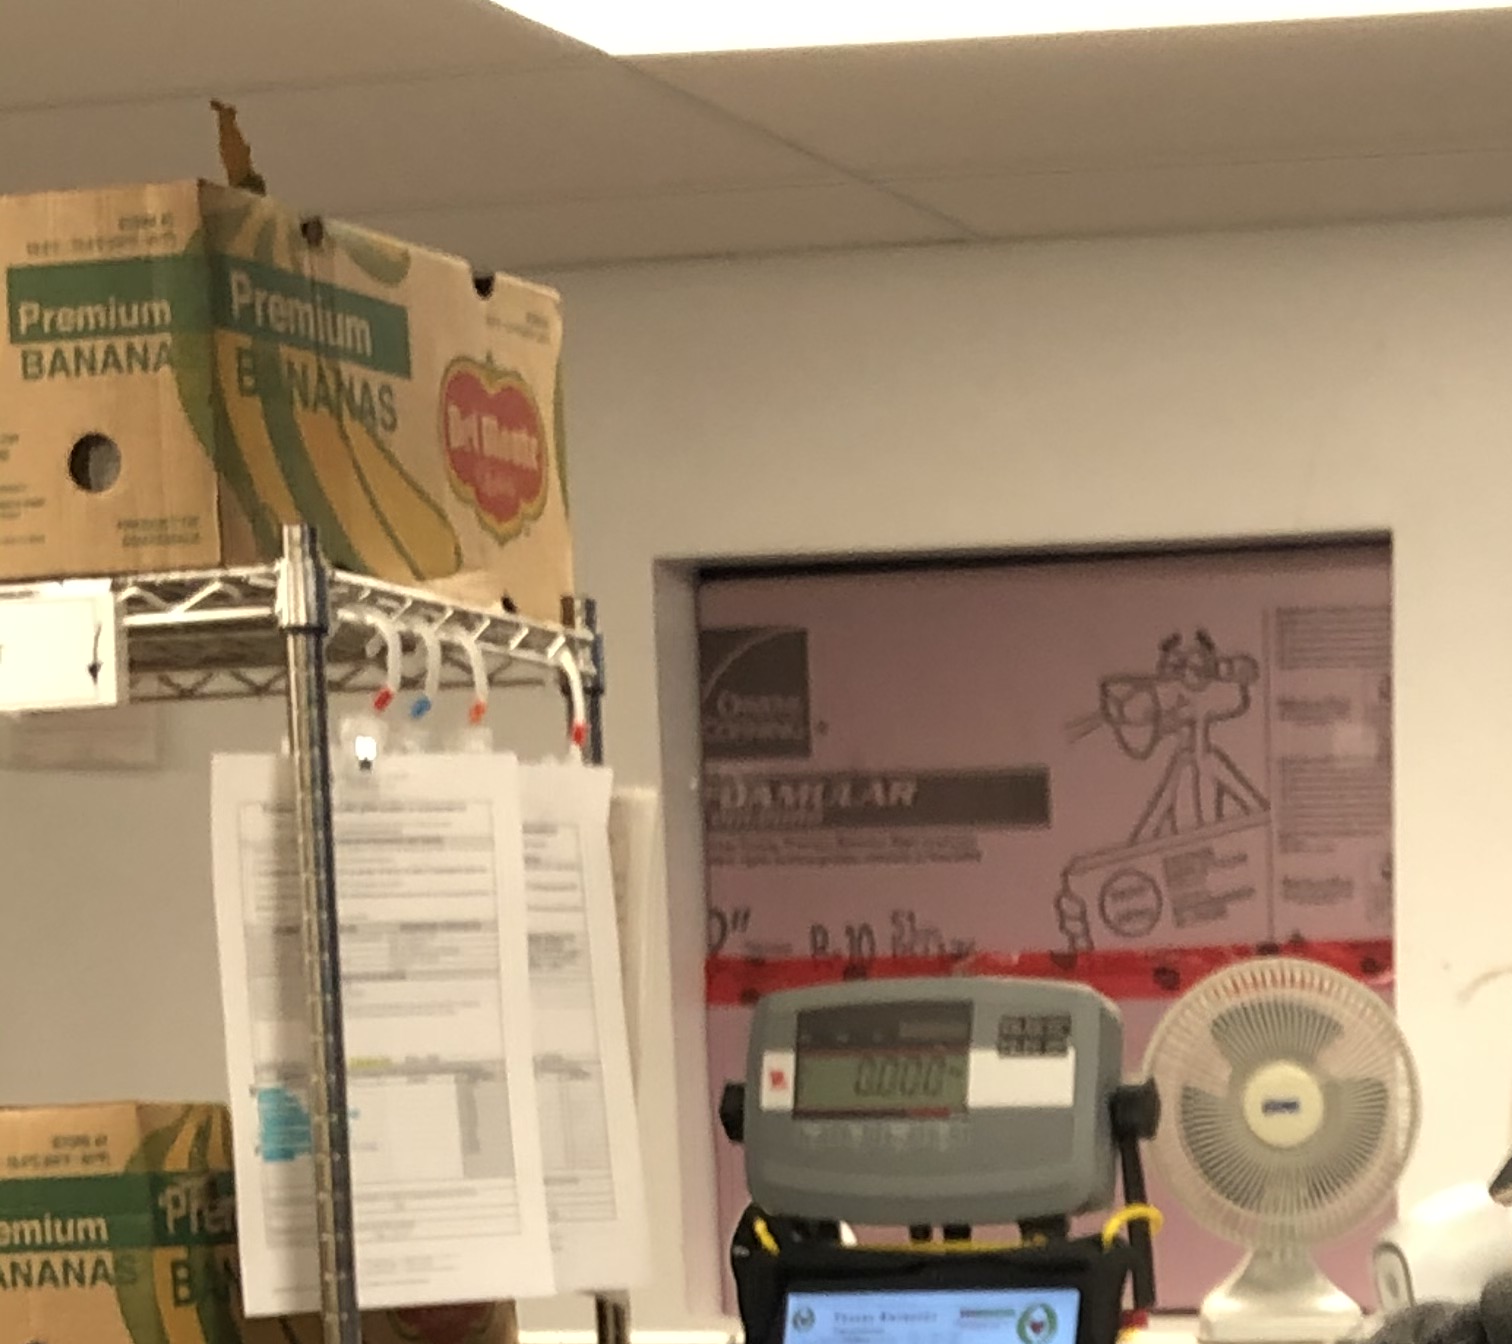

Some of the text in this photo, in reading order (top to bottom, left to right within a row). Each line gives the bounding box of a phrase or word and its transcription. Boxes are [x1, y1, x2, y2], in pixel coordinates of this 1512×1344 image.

[19, 298, 171, 334] Premium
[231, 269, 373, 356] Premium
[0, 1214, 109, 1244] emium
